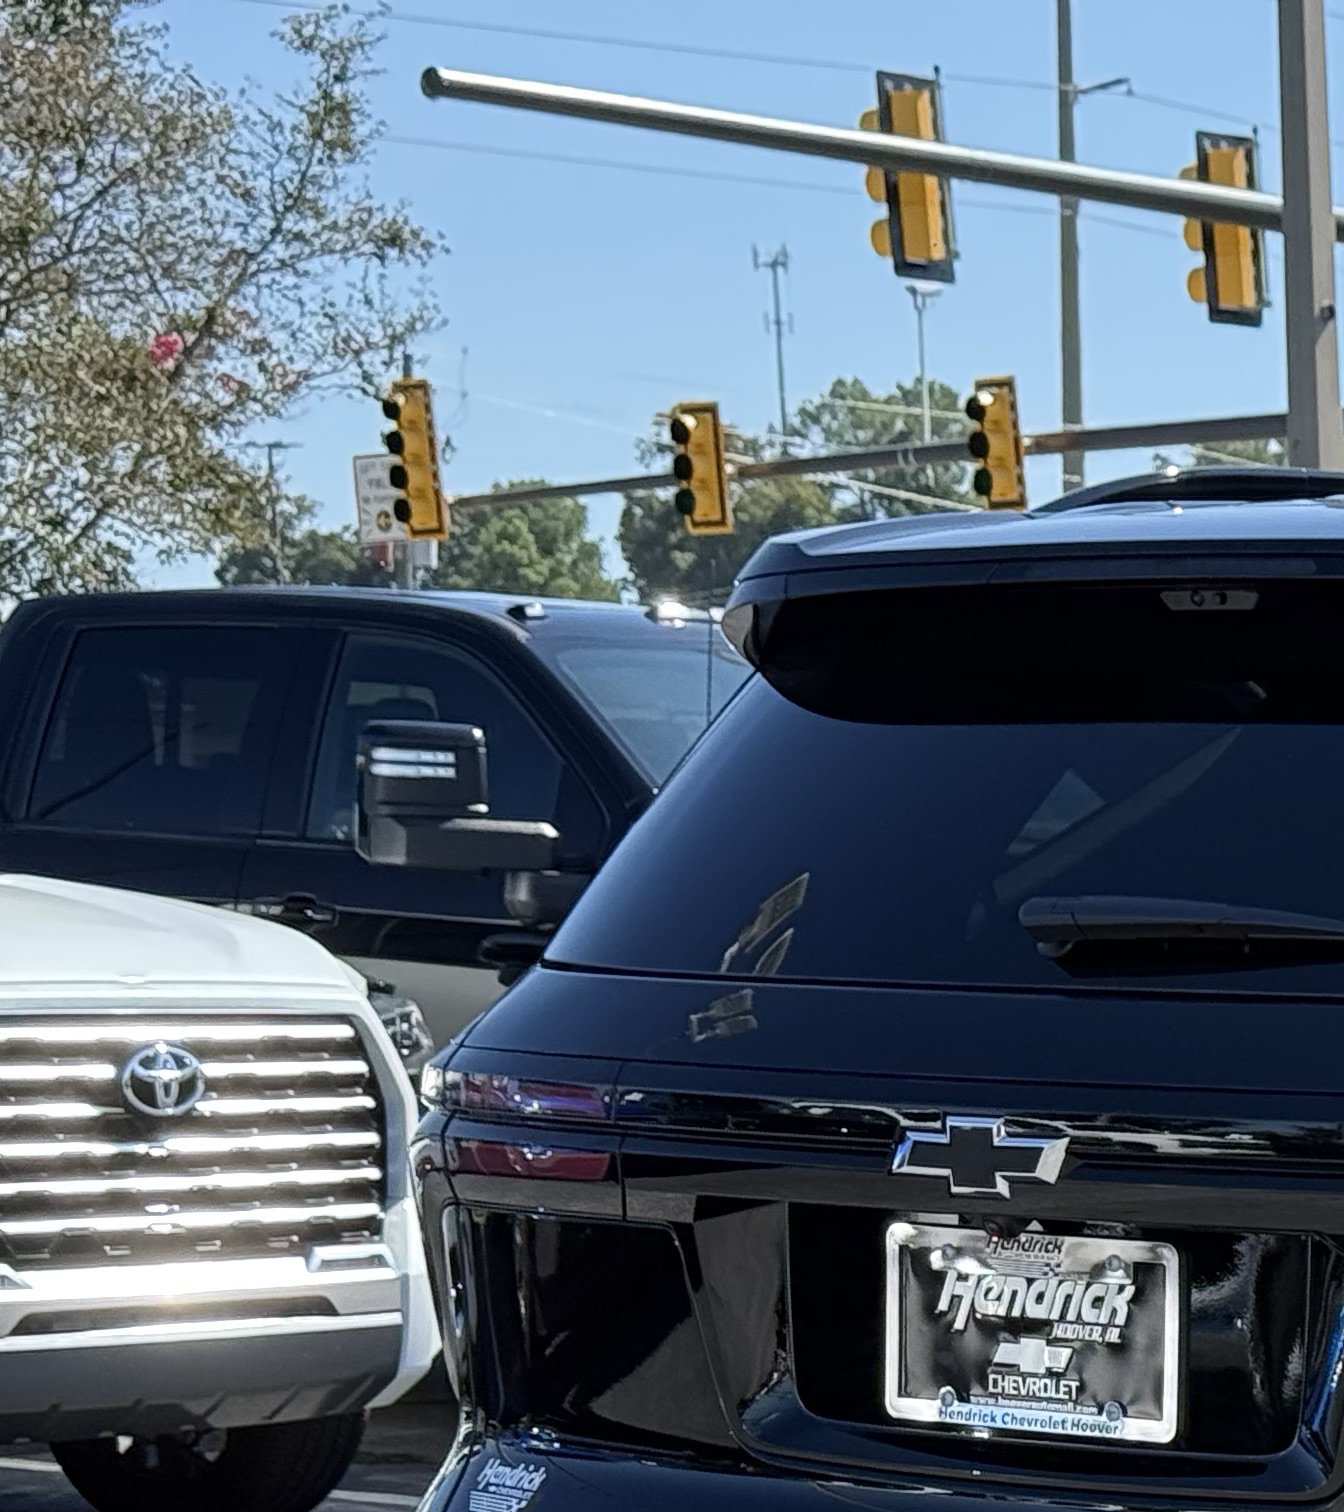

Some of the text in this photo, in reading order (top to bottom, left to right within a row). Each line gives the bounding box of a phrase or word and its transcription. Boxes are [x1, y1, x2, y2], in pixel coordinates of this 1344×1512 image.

[936, 1270, 1134, 1331] Hendrick
[987, 1373, 1080, 1400] CHEVROLET
[939, 1405, 1120, 1436] Hendrick Chevrolet Hoover
[477, 1457, 547, 1492] Hendrick
